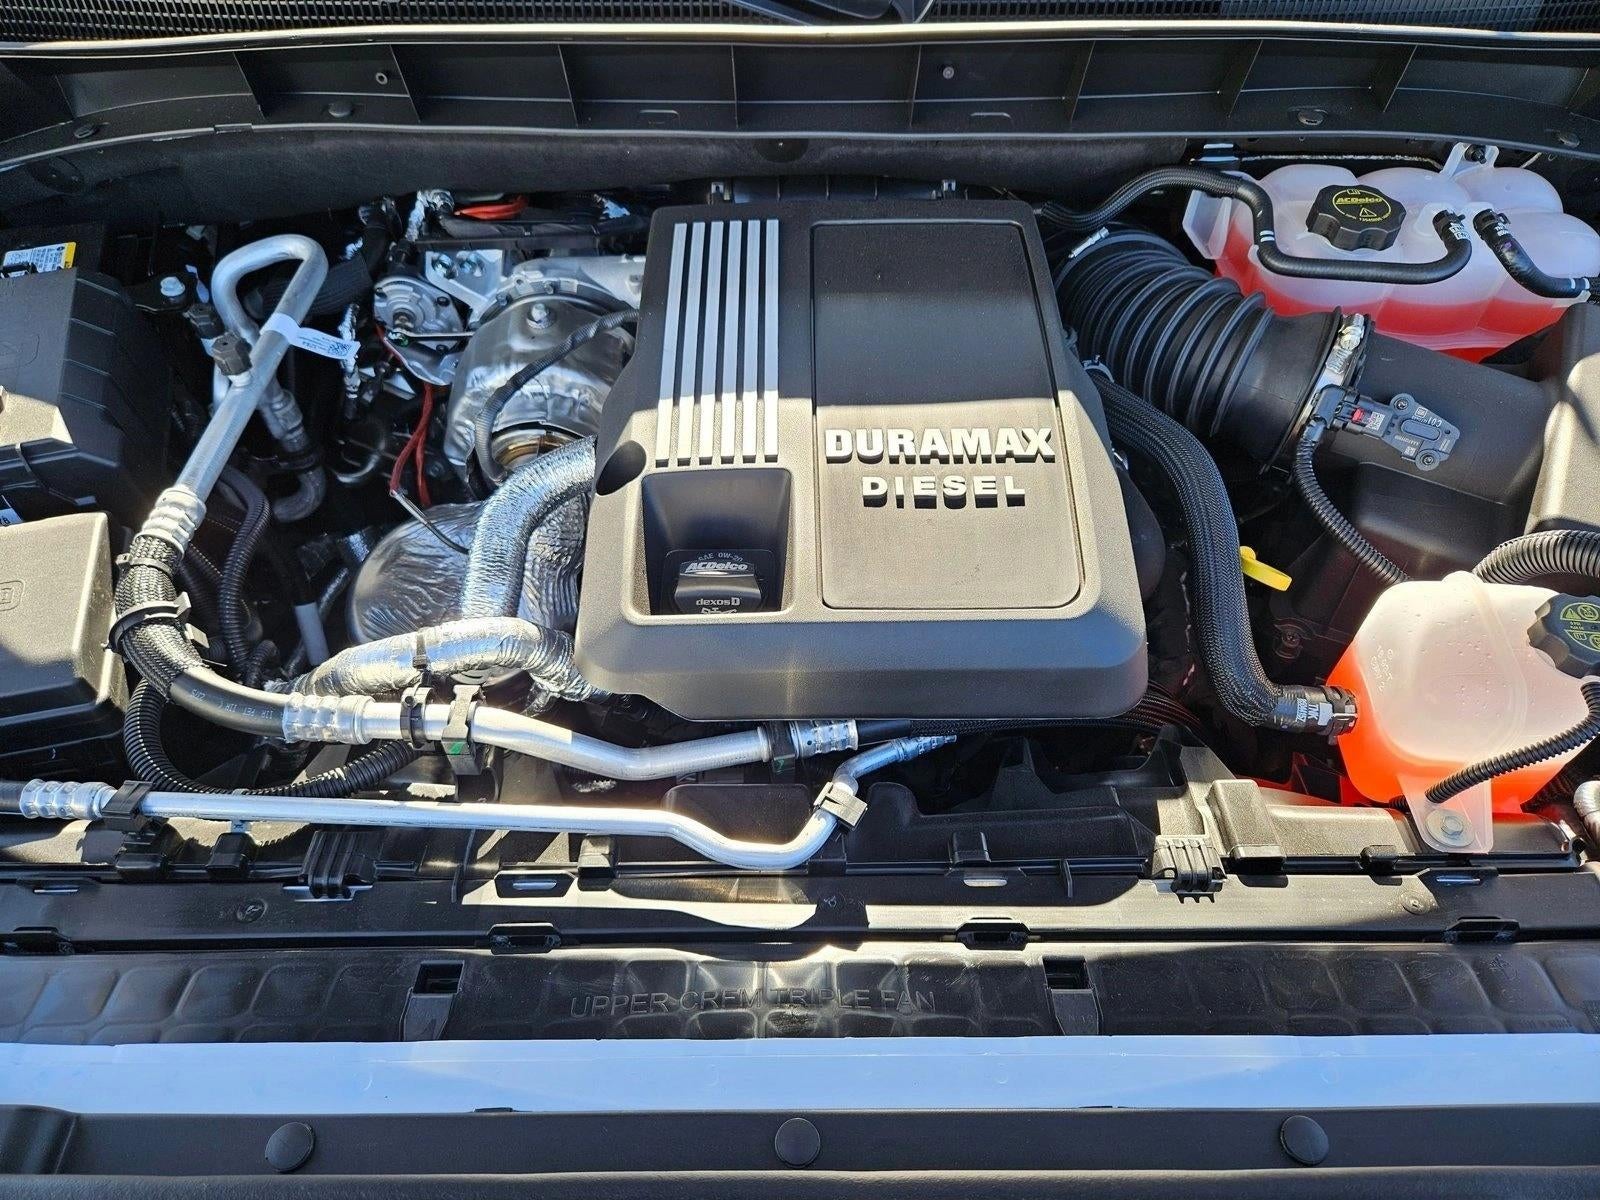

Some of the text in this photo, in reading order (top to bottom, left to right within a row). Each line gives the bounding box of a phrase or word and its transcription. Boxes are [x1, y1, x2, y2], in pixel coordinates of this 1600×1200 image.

[825, 427, 1056, 464] DURAMAX
[861, 475, 1026, 507] DIESEL
[684, 561, 748, 573] ACDelco
[570, 992, 669, 1018] UPPER
[770, 988, 872, 1010] TRIPLE
[881, 989, 936, 1016] FAN
